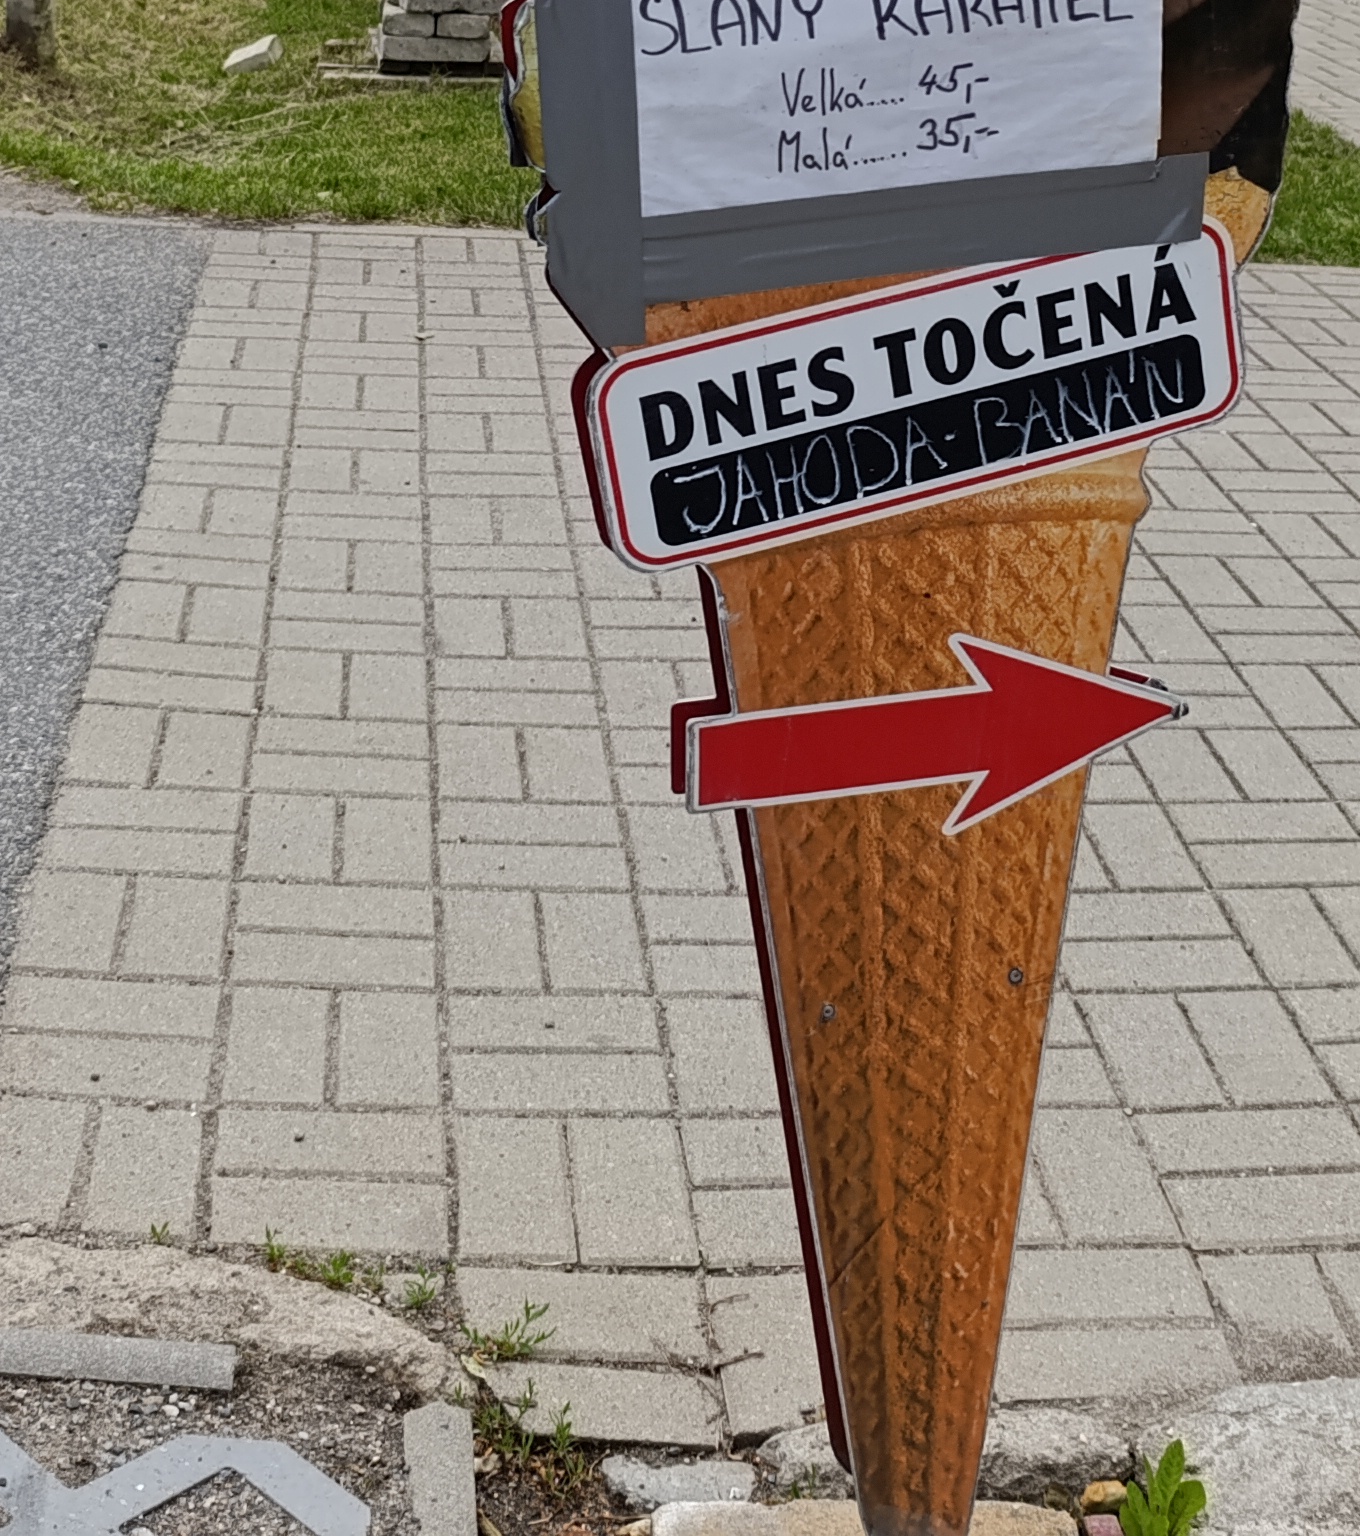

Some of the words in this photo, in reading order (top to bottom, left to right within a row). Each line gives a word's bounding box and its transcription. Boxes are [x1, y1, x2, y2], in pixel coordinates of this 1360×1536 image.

[917, 62, 990, 105] 45,-
[638, 346, 855, 462] DNES
[872, 243, 1198, 399] TOČENÁ
